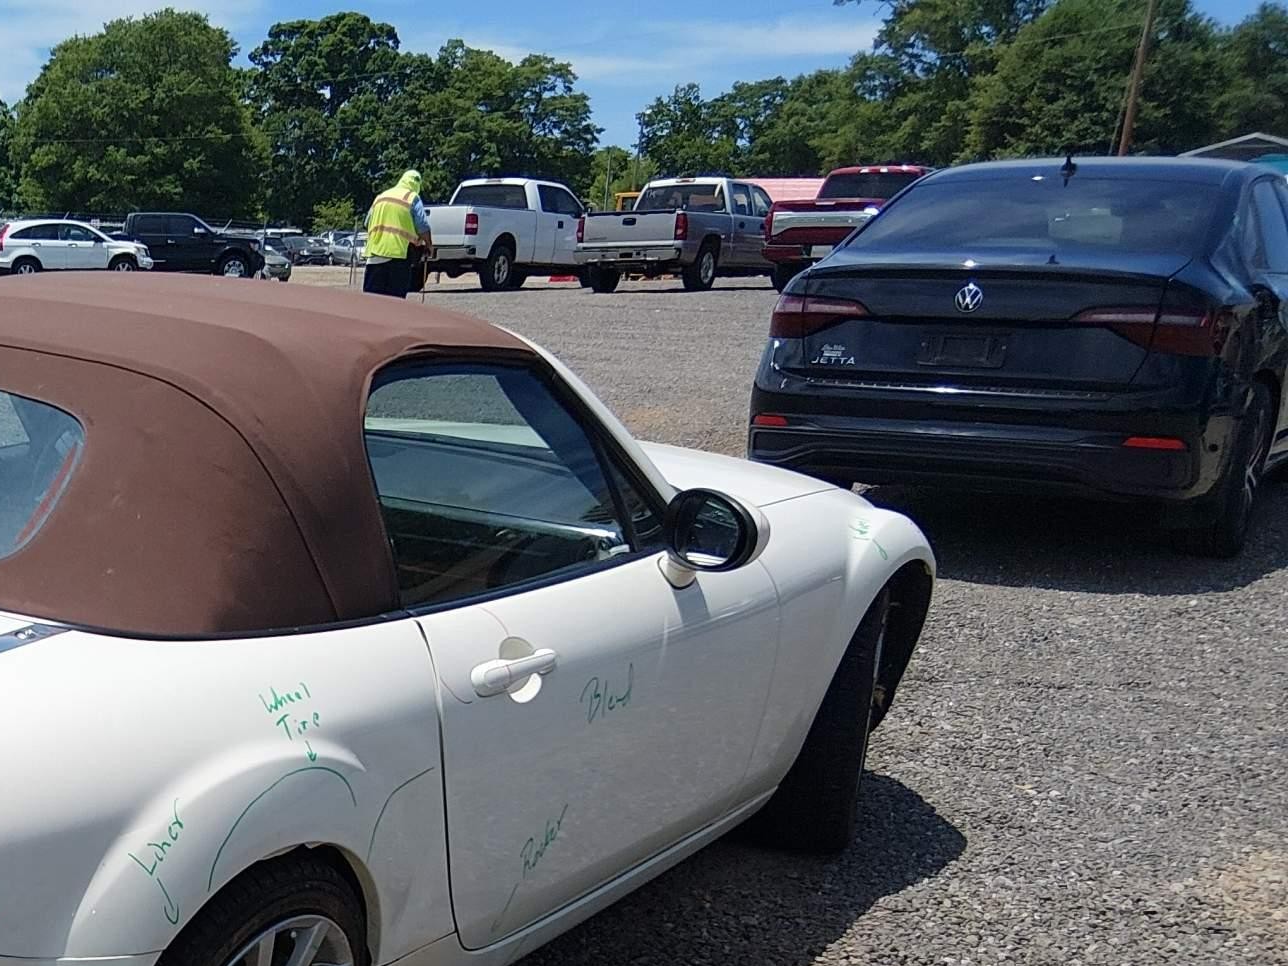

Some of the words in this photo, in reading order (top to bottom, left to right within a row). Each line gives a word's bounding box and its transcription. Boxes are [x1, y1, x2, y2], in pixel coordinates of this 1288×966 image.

[810, 356, 856, 365] JETTA
[258, 681, 312, 713] Wheel
[275, 711, 320, 741] Tire
